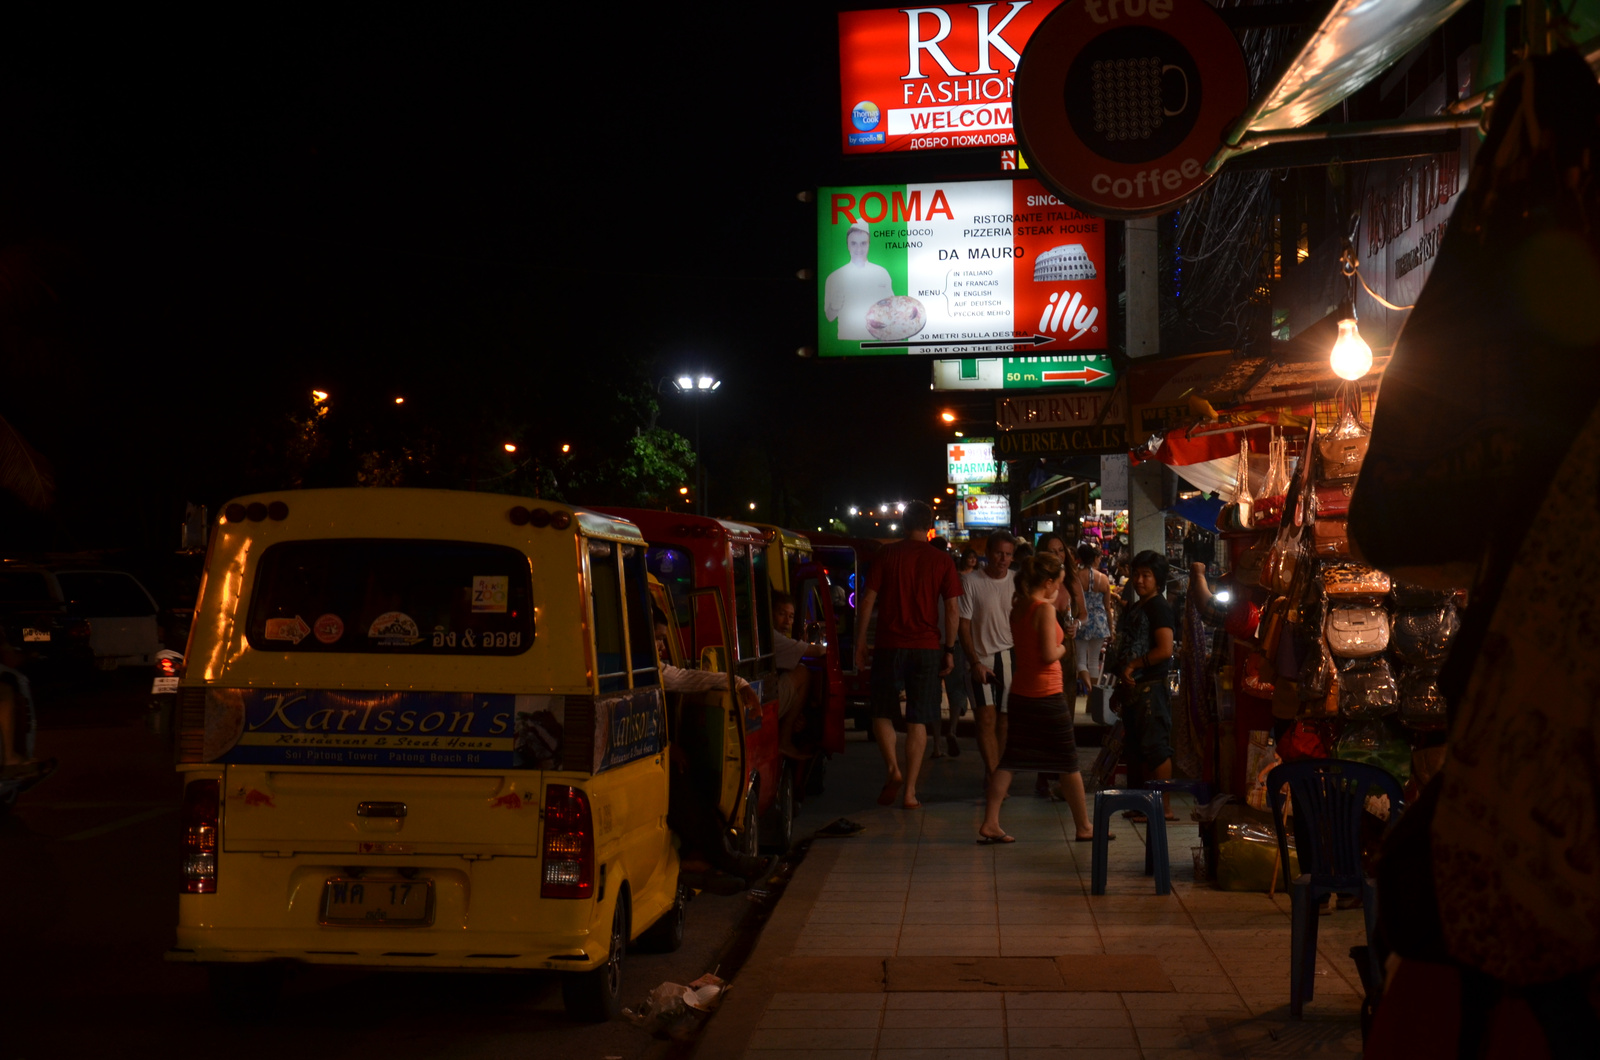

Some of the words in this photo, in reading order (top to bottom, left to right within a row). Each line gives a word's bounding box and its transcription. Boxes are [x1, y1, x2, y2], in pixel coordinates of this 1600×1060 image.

[1083, 0, 1174, 24] true
[852, 110, 879, 119] Thomas
[862, 115, 880, 124] Cook
[858, 134, 877, 144] apollo
[910, 136, 949, 150] ДОБРО
[1091, 157, 1201, 199] coffee
[831, 189, 955, 225] ROMA
[973, 213, 1043, 224] RISTORANTE
[873, 229, 896, 238] CHEF
[897, 228, 934, 238] (CUOCO)
[963, 228, 1012, 238] PIZZERIA
[1017, 226, 1054, 236] STEAK
[1060, 224, 1099, 234] HOUSE
[885, 241, 923, 249] ITALIANO
[938, 249, 960, 261] DA
[968, 246, 1025, 260] MAURO
[1038, 290, 1099, 342] illy
[1006, 372, 1021, 382] 50
[999, 395, 1102, 425] INTERNET
[999, 431, 1069, 454] OVERSEA
[1072, 428, 1120, 450] CALS
[474, 590, 506, 604] ZOO
[461, 628, 477, 648] &
[249, 694, 511, 735] Karlsson's
[275, 734, 368, 746] Restaurant
[374, 737, 389, 746] &
[397, 736, 440, 748] Steak
[448, 738, 493, 749] House
[285, 750, 302, 760] Soi
[306, 750, 343, 763] Patong
[347, 751, 378, 761] Tower
[388, 751, 425, 764] Patong
[430, 751, 462, 763] Beach
[467, 753, 480, 764] Rd
[389, 884, 412, 906] 17
